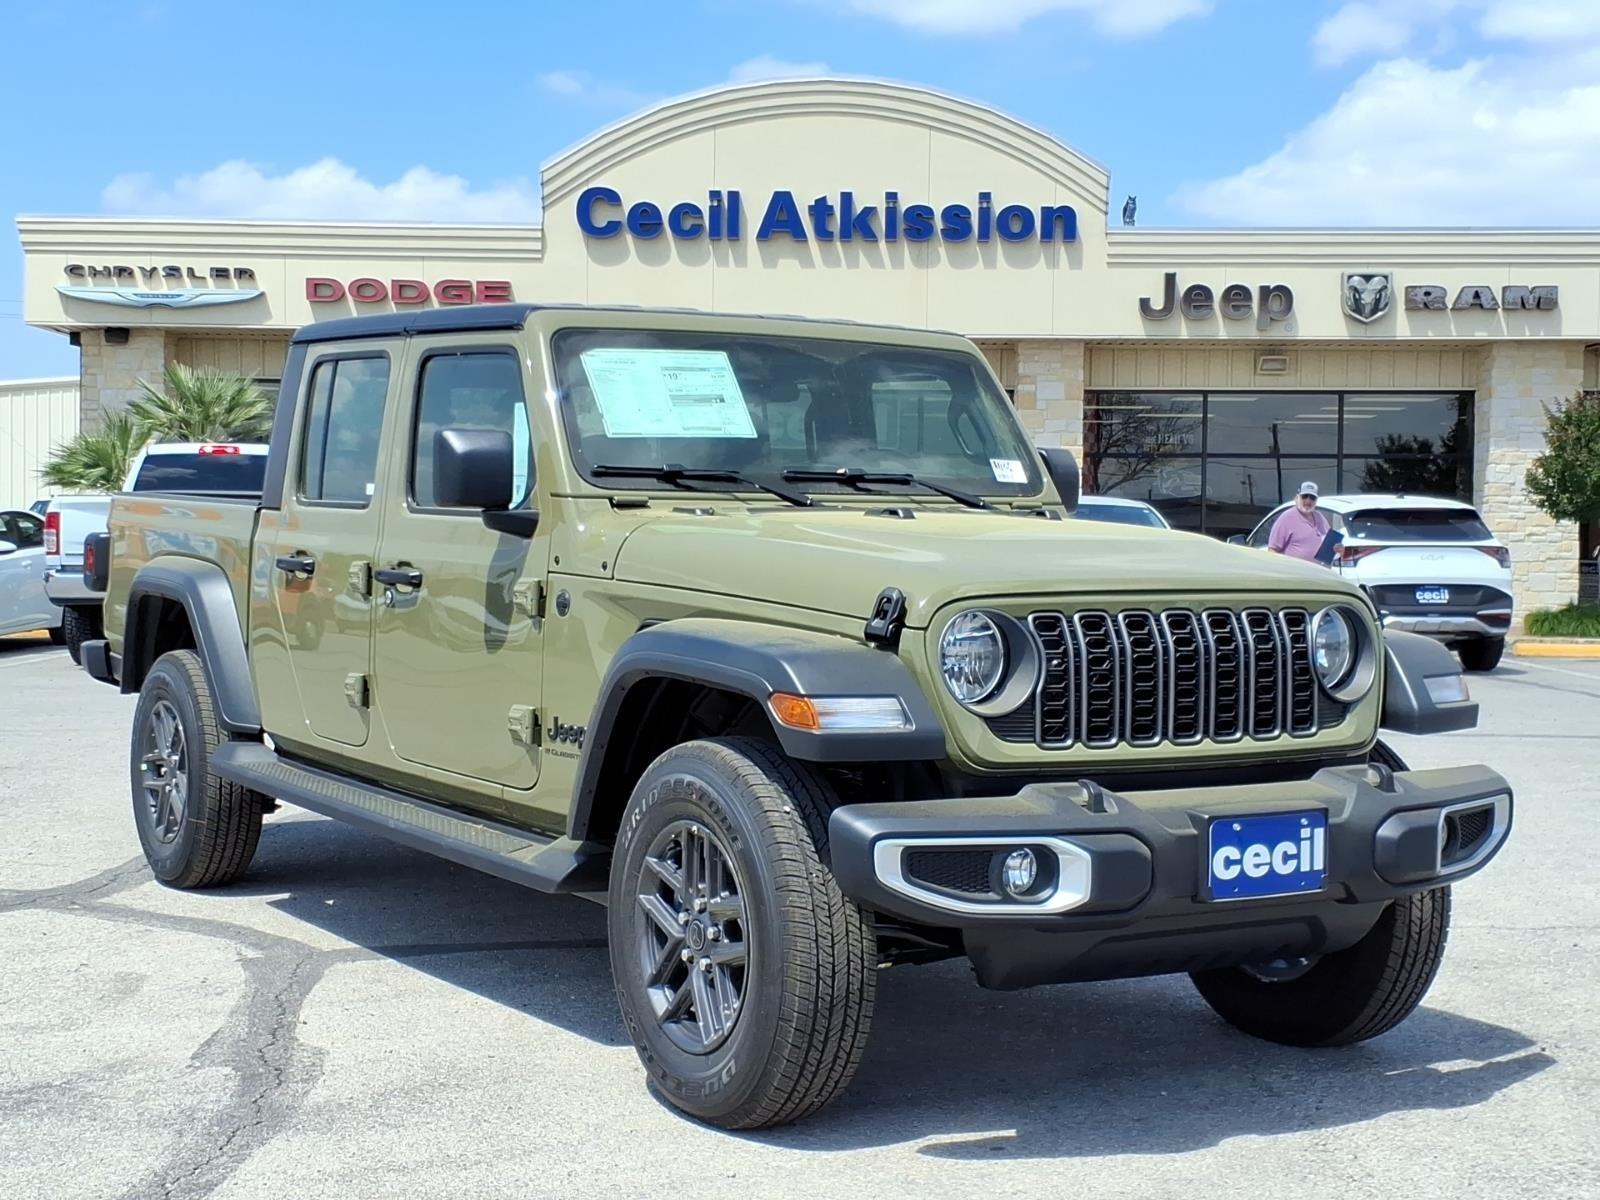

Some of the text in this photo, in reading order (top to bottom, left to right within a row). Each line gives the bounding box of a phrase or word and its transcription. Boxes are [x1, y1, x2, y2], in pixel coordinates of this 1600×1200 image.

[576, 187, 1078, 243] Cecil Atkission
[64, 264, 255, 281] CHRYSLER
[305, 277, 511, 305] DODGE
[1138, 271, 1295, 331] Jeep
[1404, 285, 1559, 311] RAM
[1415, 588, 1450, 600] cecil
[546, 715, 587, 750] Jeep
[1212, 827, 1325, 880] cecil
